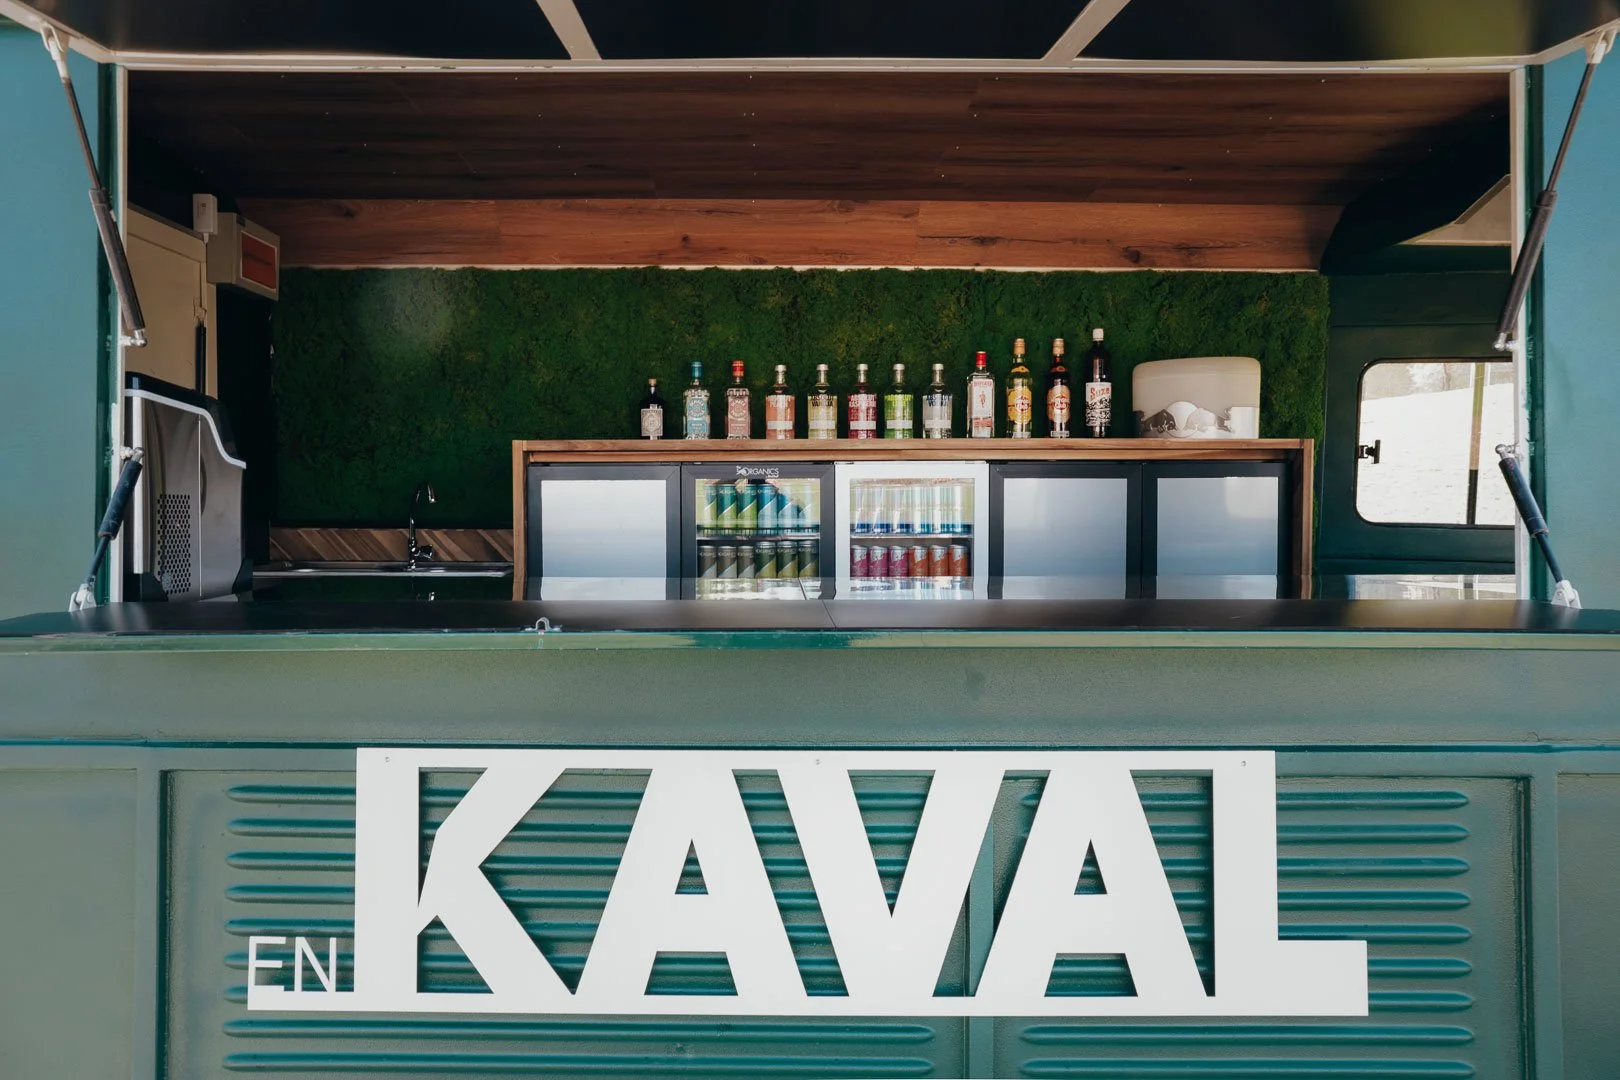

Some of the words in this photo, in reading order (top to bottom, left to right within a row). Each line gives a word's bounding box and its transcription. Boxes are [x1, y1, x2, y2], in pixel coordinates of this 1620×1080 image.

[741, 467, 780, 476] ORGANICS
[248, 936, 337, 993] EN
[354, 747, 1369, 1017] KAVAL
